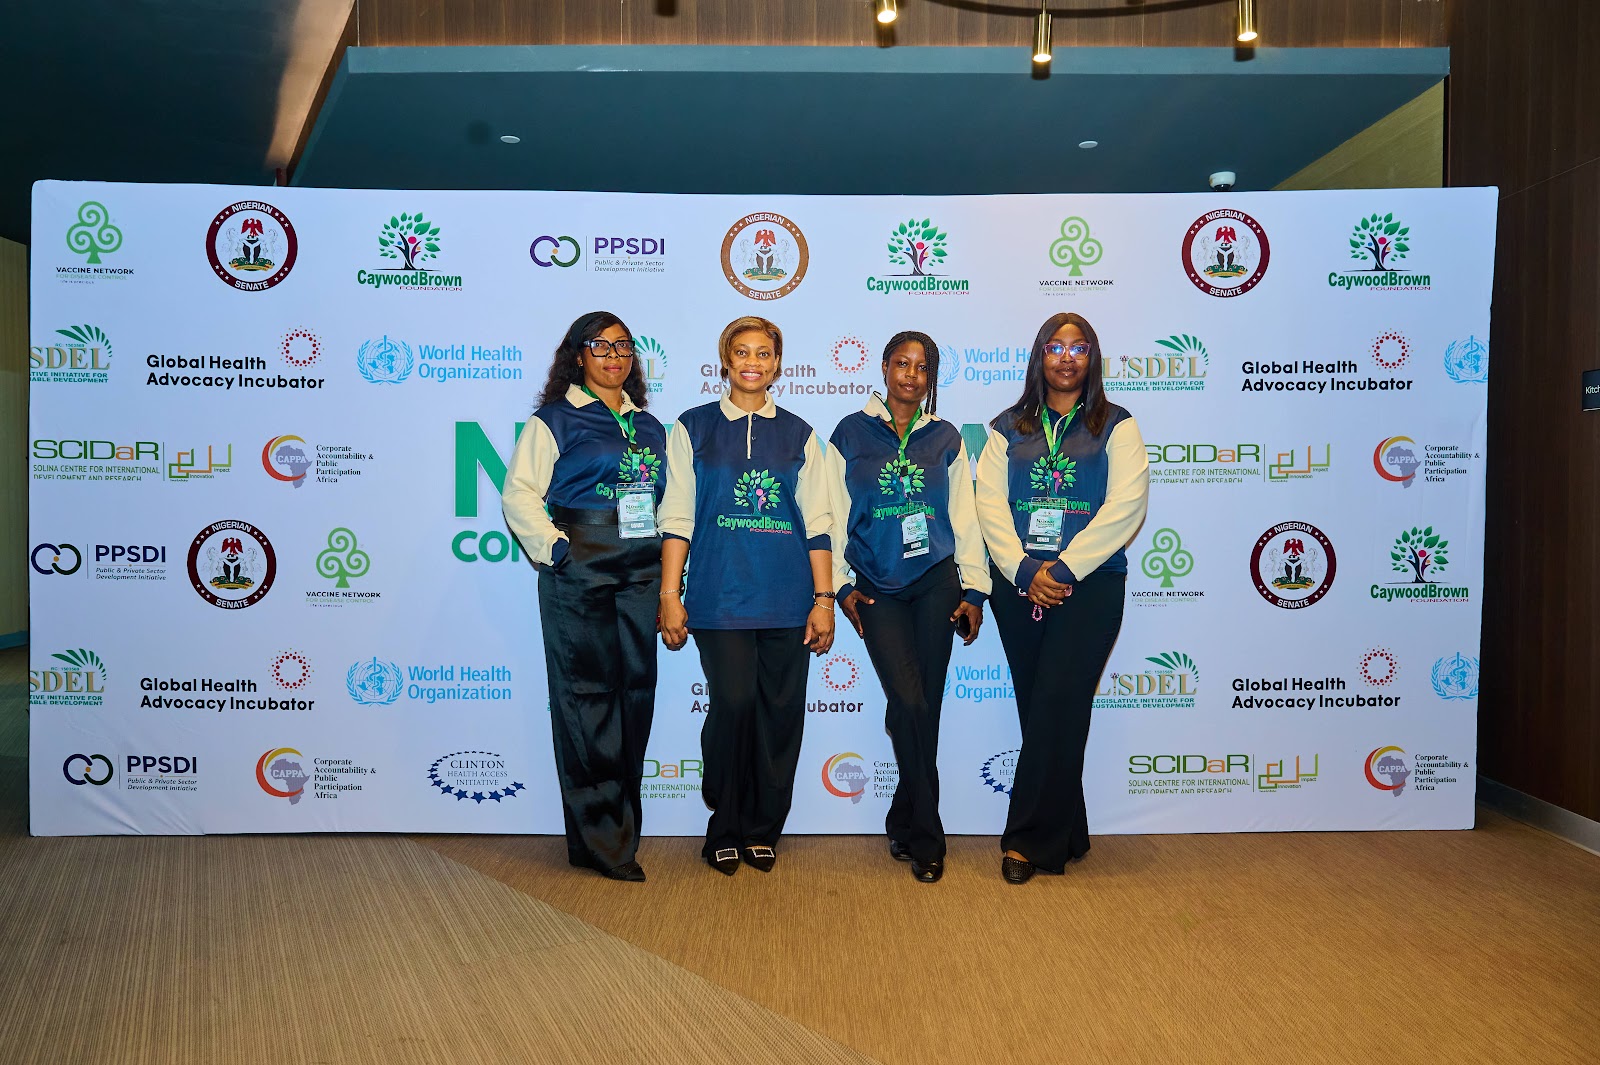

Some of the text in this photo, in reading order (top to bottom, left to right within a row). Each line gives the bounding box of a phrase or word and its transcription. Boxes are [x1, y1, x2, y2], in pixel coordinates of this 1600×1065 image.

[231, 202, 274, 215] NIGERIAN
[744, 213, 785, 225] NIGERIAN
[1205, 210, 1245, 222] NIGERIAN
[595, 238, 664, 255] PPSDI
[234, 279, 269, 290] SENATE
[358, 270, 462, 289] CaywoodBrown
[867, 277, 969, 294] CaywoodBrown
[1329, 271, 1430, 290] CaywoodBrown
[748, 288, 782, 300] SENATE
[1209, 286, 1243, 297] SENATE
[419, 345, 521, 361] World Health
[965, 348, 1009, 362] World
[147, 355, 266, 369] Global Health
[1242, 361, 1357, 374] Global Health
[419, 363, 522, 382] Organization
[964, 366, 1025, 385] Organiz
[147, 372, 324, 390] Advocacy Incubator
[1242, 378, 1413, 393] Advocacy Incubator
[790, 382, 872, 395] Incubator
[33, 440, 159, 460] SCIDaR
[1425, 445, 1458, 453] Corporate
[277, 454, 307, 464] CAPPA
[317, 453, 366, 461] Accountability
[1388, 456, 1416, 465] CAPPA
[1425, 452, 1472, 460] Accountability
[317, 468, 360, 476] Participation
[1425, 468, 1467, 476] Participation
[211, 521, 252, 533] NIGERIAN
[717, 514, 792, 531] CaywoodBrown
[1273, 522, 1314, 534] NIGERIAN
[96, 545, 165, 562] PPSDI
[1371, 584, 1468, 602] CaywoodBrown
[215, 598, 250, 609] SENATE
[1276, 598, 1310, 609] SENATE
[408, 665, 511, 681] World Health
[956, 665, 1000, 680] World
[140, 678, 256, 692] Global Health
[1232, 678, 1345, 691] Global Health
[408, 684, 511, 704] Organization
[956, 683, 1015, 702] Organiz
[141, 695, 314, 712] Advocacy Incubator
[807, 700, 863, 712] ubator
[1232, 695, 1400, 710] Advocacy Incubator
[127, 756, 196, 773] PPSDI
[314, 758, 352, 766] Corporate
[1129, 755, 1249, 774] SCIDaR
[1415, 754, 1448, 763] Corporate
[315, 767, 367, 775] Accountability
[1379, 765, 1406, 773] CAPPA
[1415, 762, 1461, 770] Accountability
[272, 769, 304, 778] CAPPA
[836, 772, 865, 780] CAPPA
[315, 783, 362, 791] Participation
[314, 790, 338, 798] Africa
